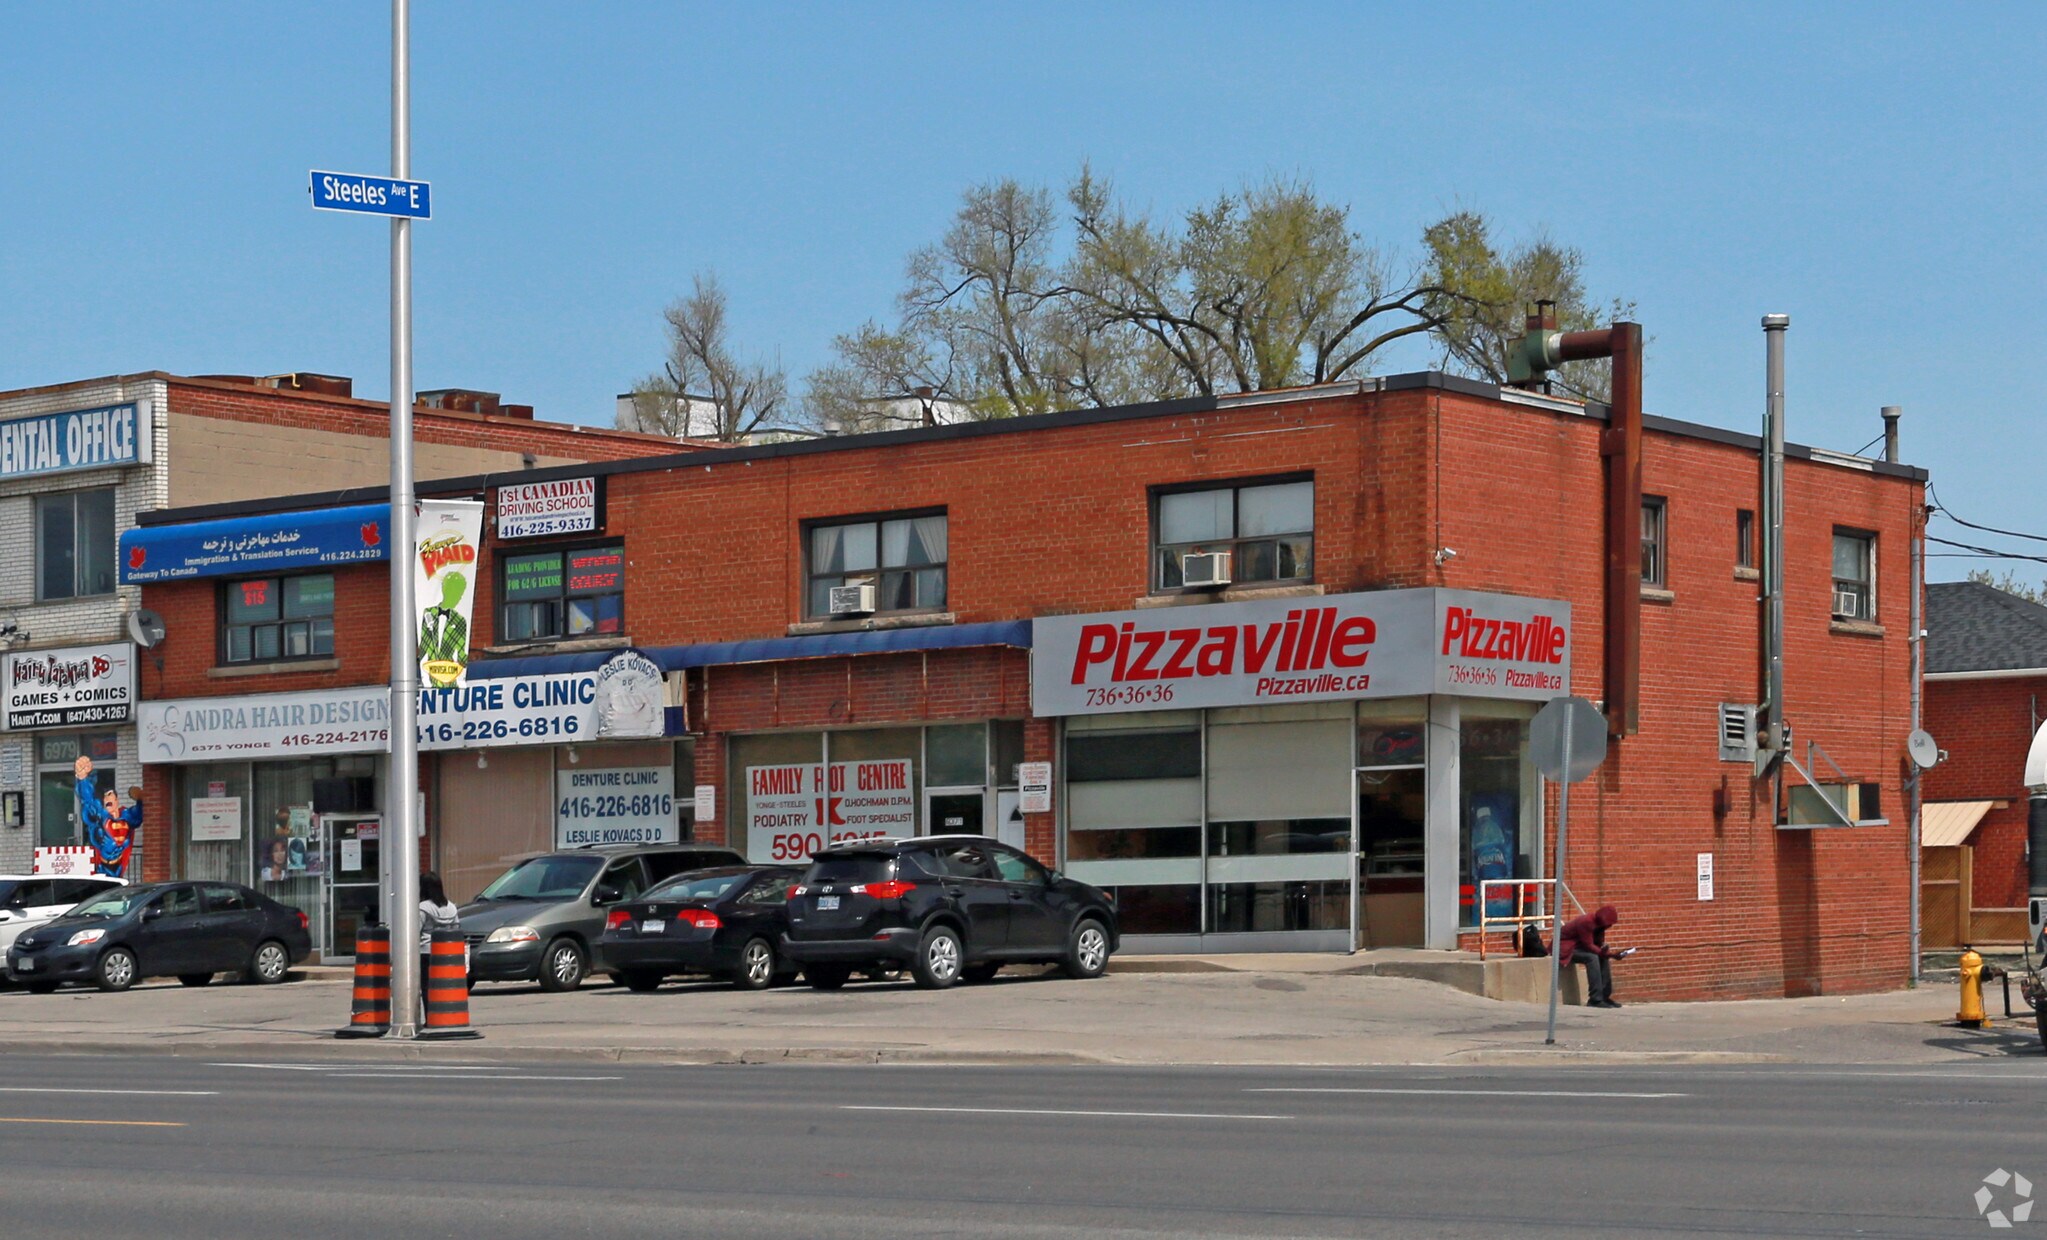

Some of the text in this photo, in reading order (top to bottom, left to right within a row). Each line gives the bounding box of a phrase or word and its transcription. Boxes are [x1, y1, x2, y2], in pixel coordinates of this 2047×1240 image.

[323, 176, 420, 208] Steeles Ave E
[0, 408, 132, 474] ENTAL OFFICE
[522, 479, 594, 500] CANADIAN
[500, 496, 594, 516] DRIVING SCHOOL
[271, 530, 300, 544] خدمات
[502, 517, 592, 537] 416-225-9337
[202, 537, 228, 552] ترجمه
[229, 540, 234, 552] و
[184, 547, 320, 566] Immigration & Translation Services
[320, 549, 382, 561] 416.224.2829
[420, 544, 476, 580] PLAID
[128, 567, 198, 580] Gateway To Canada
[1442, 606, 1566, 664] Pizzaville
[1071, 607, 1377, 684] Pizzaville
[601, 659, 625, 682] LESLIE
[1505, 668, 1562, 691] Pizzaville.ca
[1255, 672, 1370, 698] Pizzaville.ca
[12, 687, 127, 706] GAMES + COMICS
[418, 678, 595, 715] NTURE CLINIC
[183, 708, 248, 732] ANDRA
[252, 704, 305, 728] HAIR
[226, 742, 271, 750] YONGE
[282, 729, 388, 748] 416-224-2176
[44, 740, 76, 759] 6979
[572, 771, 658, 787] DENTURE CLINIC
[752, 763, 906, 796] FAMILY FOT CENTRE
[560, 794, 672, 818] 416-226-6816
[754, 814, 808, 828] PODIATRY
[846, 813, 912, 824] FOOT SPECIALIST
[566, 830, 600, 843] LESLIE
[603, 830, 643, 842] KOVACS
[646, 829, 652, 840] D
